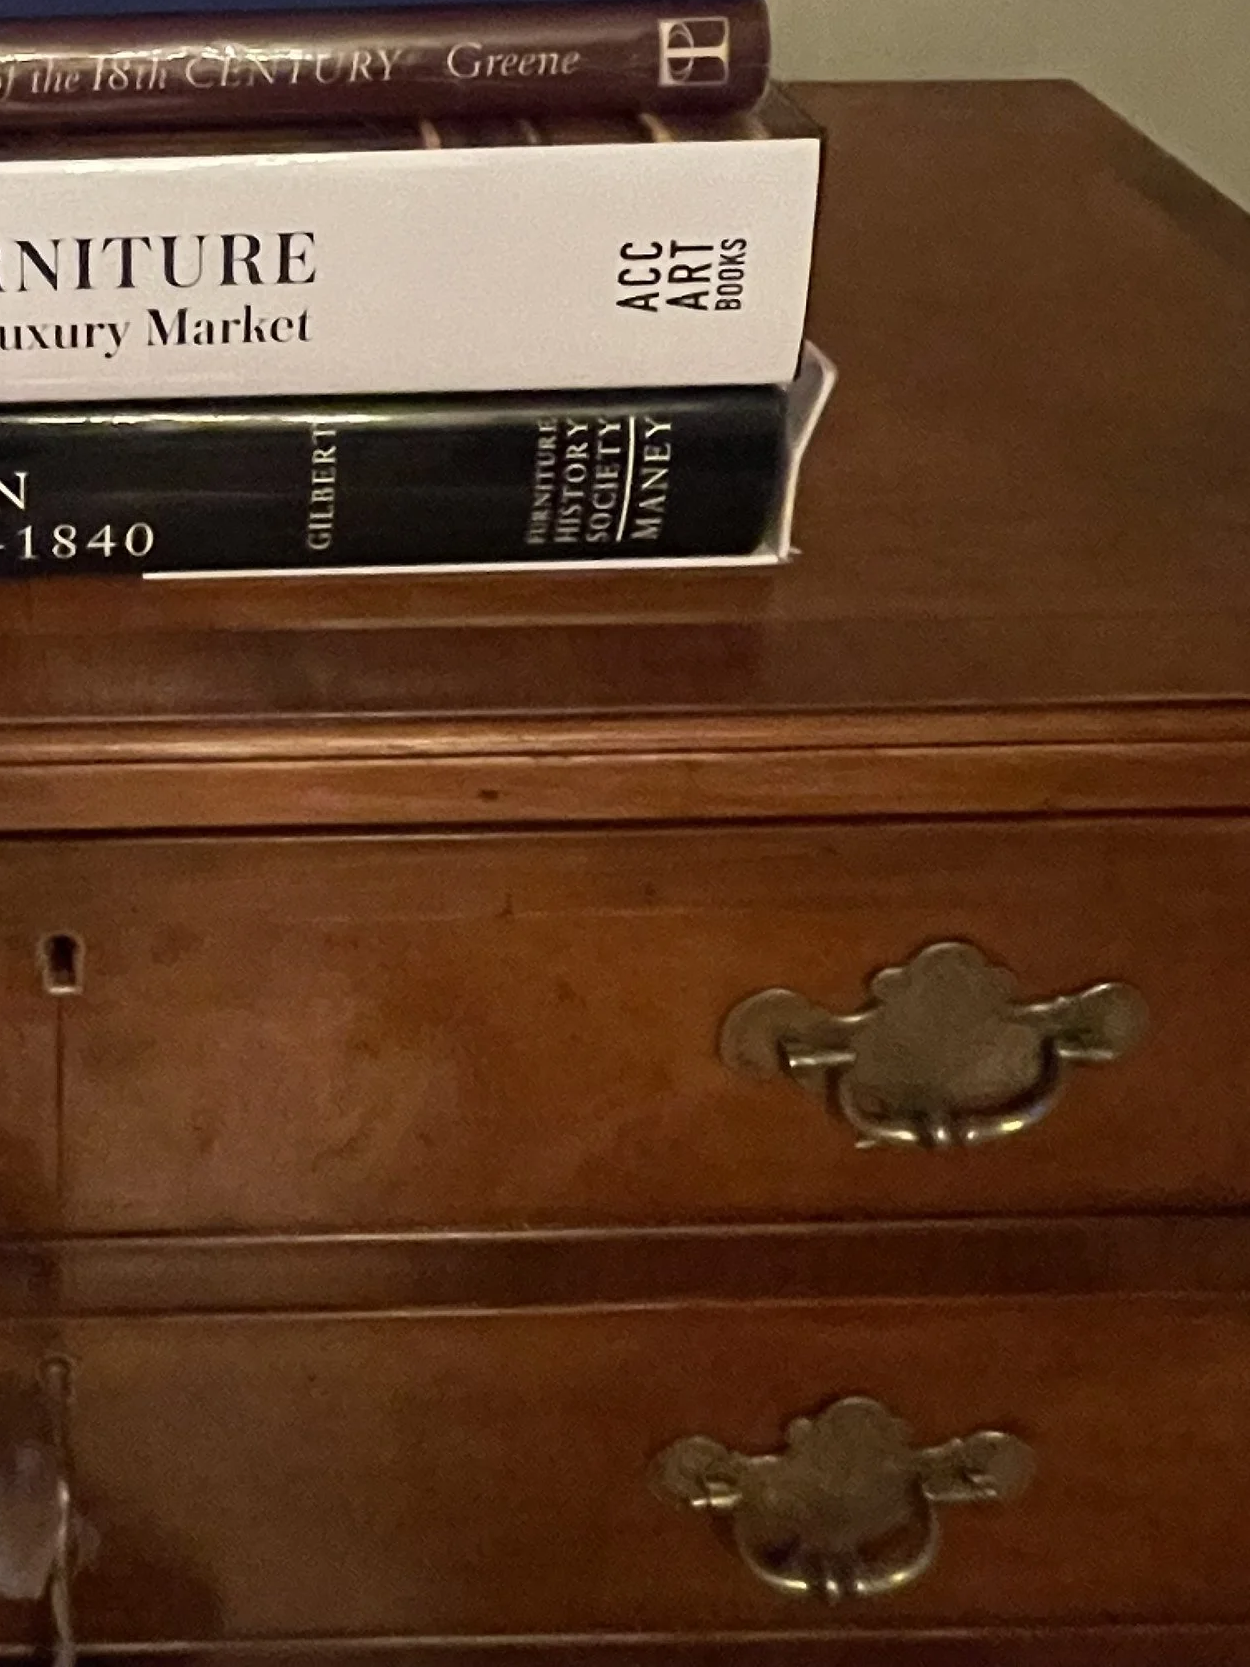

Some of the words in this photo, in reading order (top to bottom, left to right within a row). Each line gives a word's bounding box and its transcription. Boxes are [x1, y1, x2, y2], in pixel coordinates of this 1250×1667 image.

[31, 59, 81, 93] the
[91, 54, 170, 92] 18th
[183, 46, 404, 90] CENTURY
[447, 41, 580, 81] Greene
[616, 239, 664, 312] ACC
[666, 239, 713, 310] ART
[716, 237, 748, 311] BOOKS
[146, 304, 312, 349] Market
[306, 421, 337, 551] GILBERT
[527, 417, 558, 544] FURNITURE
[554, 417, 589, 543] HISTORY
[586, 417, 622, 543] SOCIETY
[632, 417, 672, 540] MANEY
